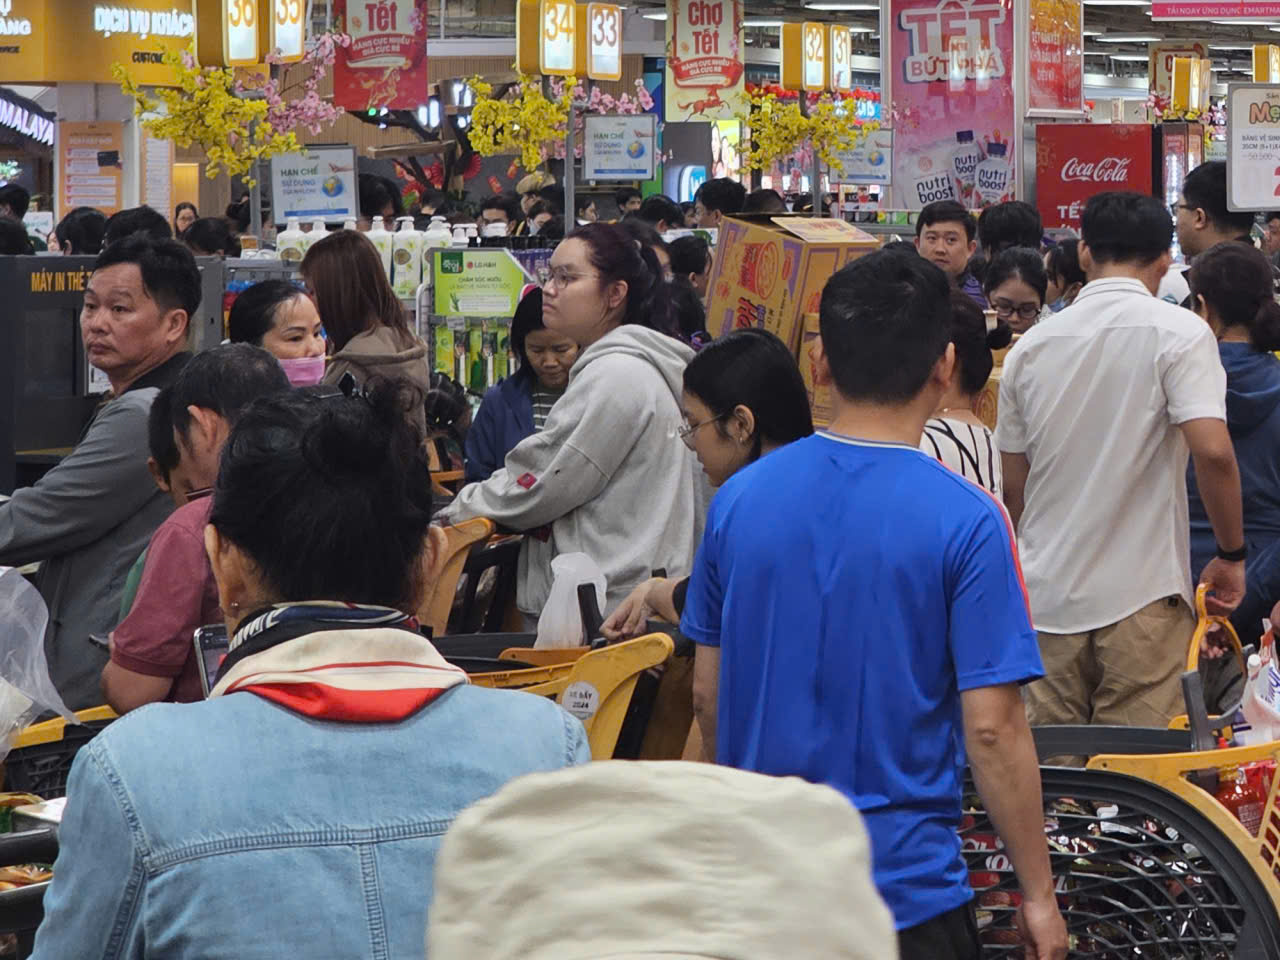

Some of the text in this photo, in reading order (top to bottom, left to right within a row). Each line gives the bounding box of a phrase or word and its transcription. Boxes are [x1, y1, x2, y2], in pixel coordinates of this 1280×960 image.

[94, 5, 129, 38] DỊCH
[131, 9, 151, 40] VỤ
[366, 0, 398, 32] Tết
[543, 4, 575, 43] 34
[592, 8, 617, 47] 33
[687, 0, 723, 29] Chợ
[692, 28, 720, 55] Tết
[806, 29, 824, 62] 32
[911, 57, 949, 77] BỨT
[916, 173, 951, 193] nutri
[978, 168, 1007, 180] nutri
[978, 177, 1007, 190] boost
[918, 185, 955, 205] boost
[32, 265, 85, 292] MÁY IN THẺ
